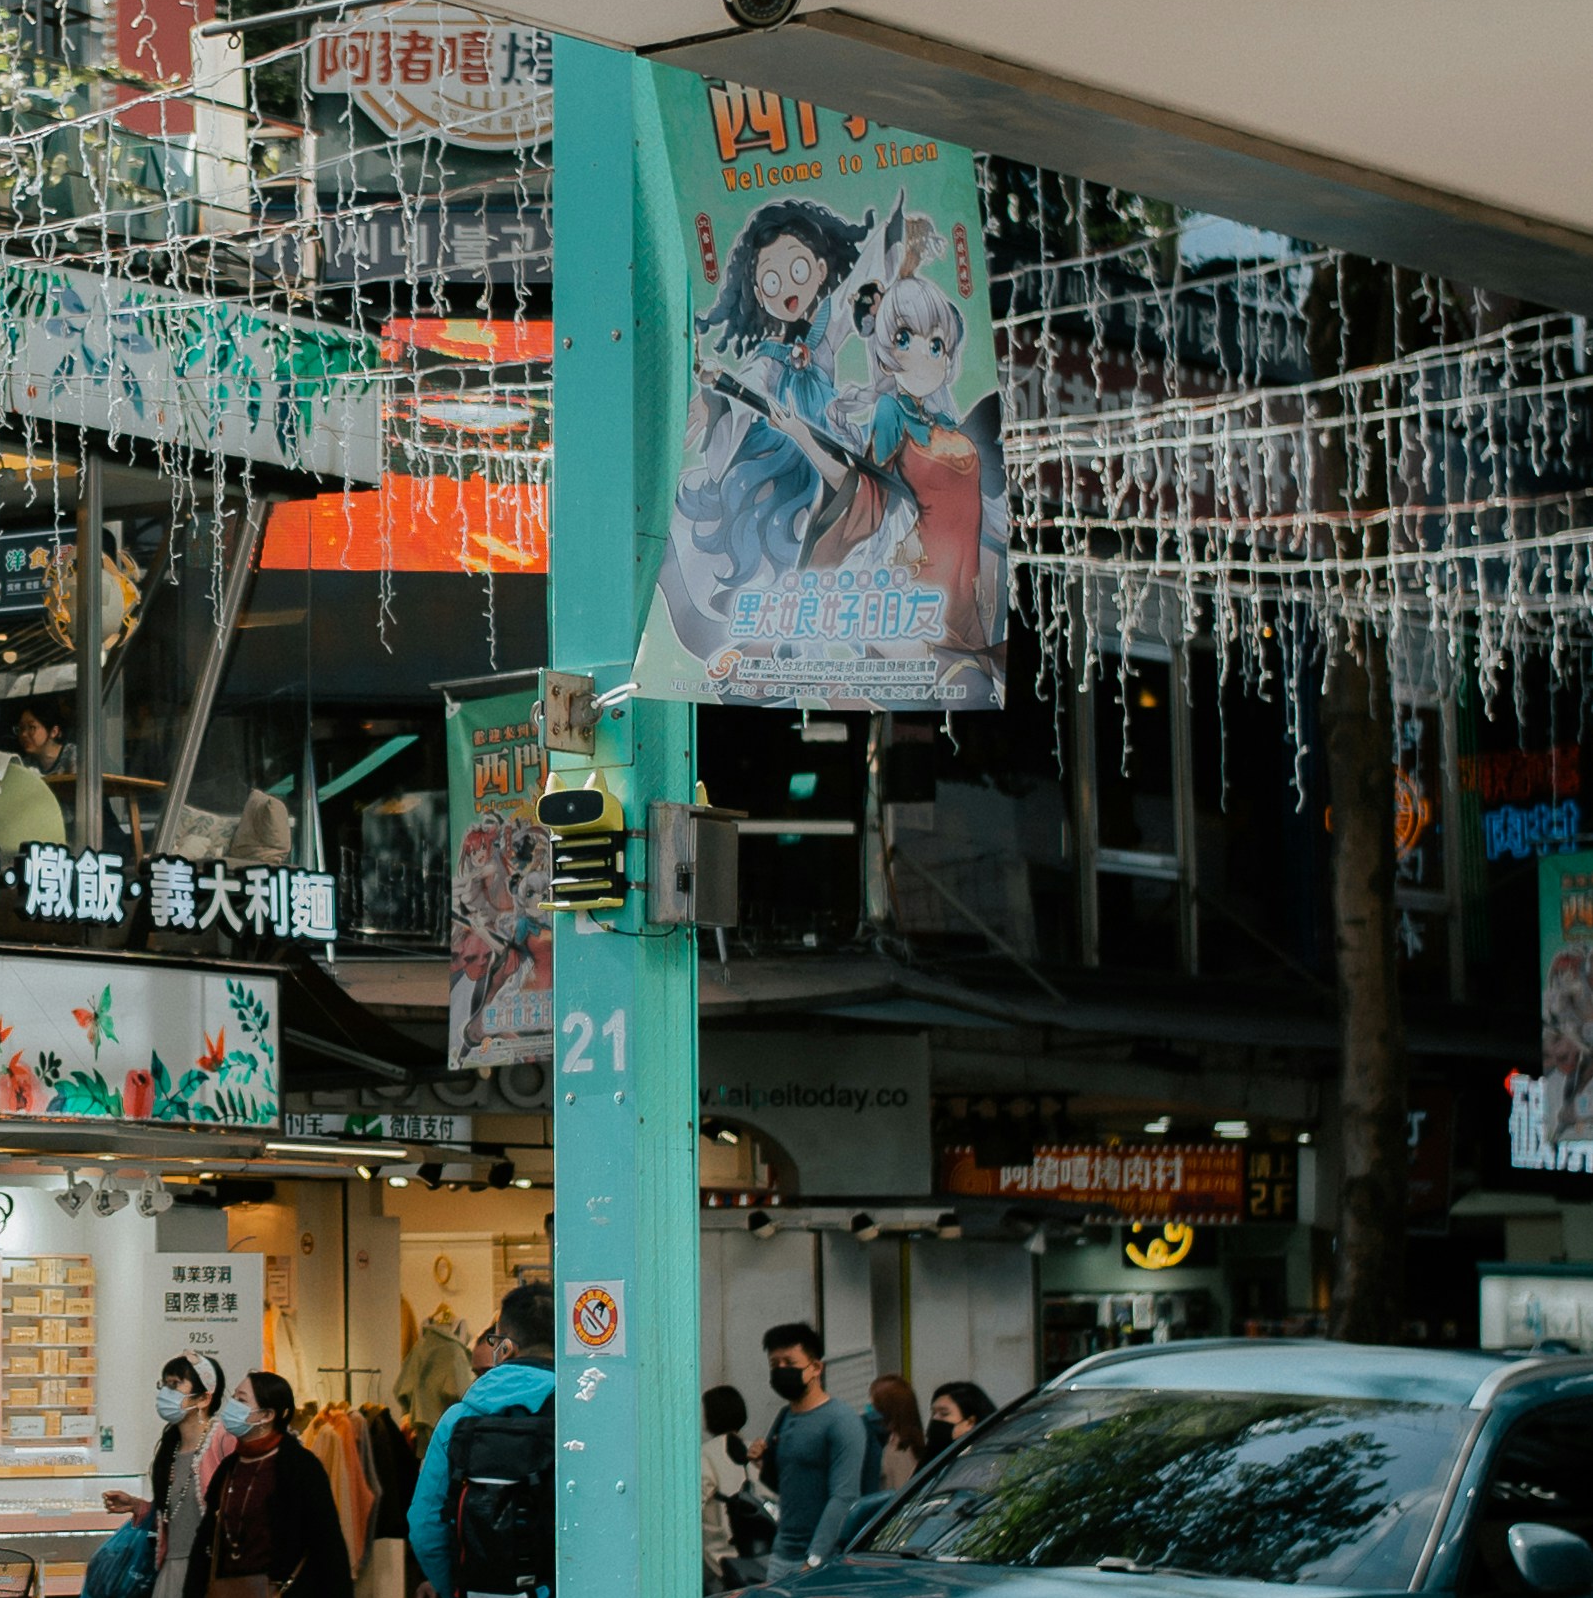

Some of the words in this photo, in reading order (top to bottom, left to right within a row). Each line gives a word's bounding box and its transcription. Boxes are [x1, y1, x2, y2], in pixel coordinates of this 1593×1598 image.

[722, 161, 823, 192] Welcome
[839, 154, 863, 175] to
[875, 142, 939, 169] Ximen
[732, 589, 945, 639] 默娘好朋友
[561, 1009, 626, 1073] 21
[390, 1115, 454, 1140] 微信支付
[172, 1265, 231, 1284] 專業穿洞
[165, 1292, 238, 1313] 國際標準
